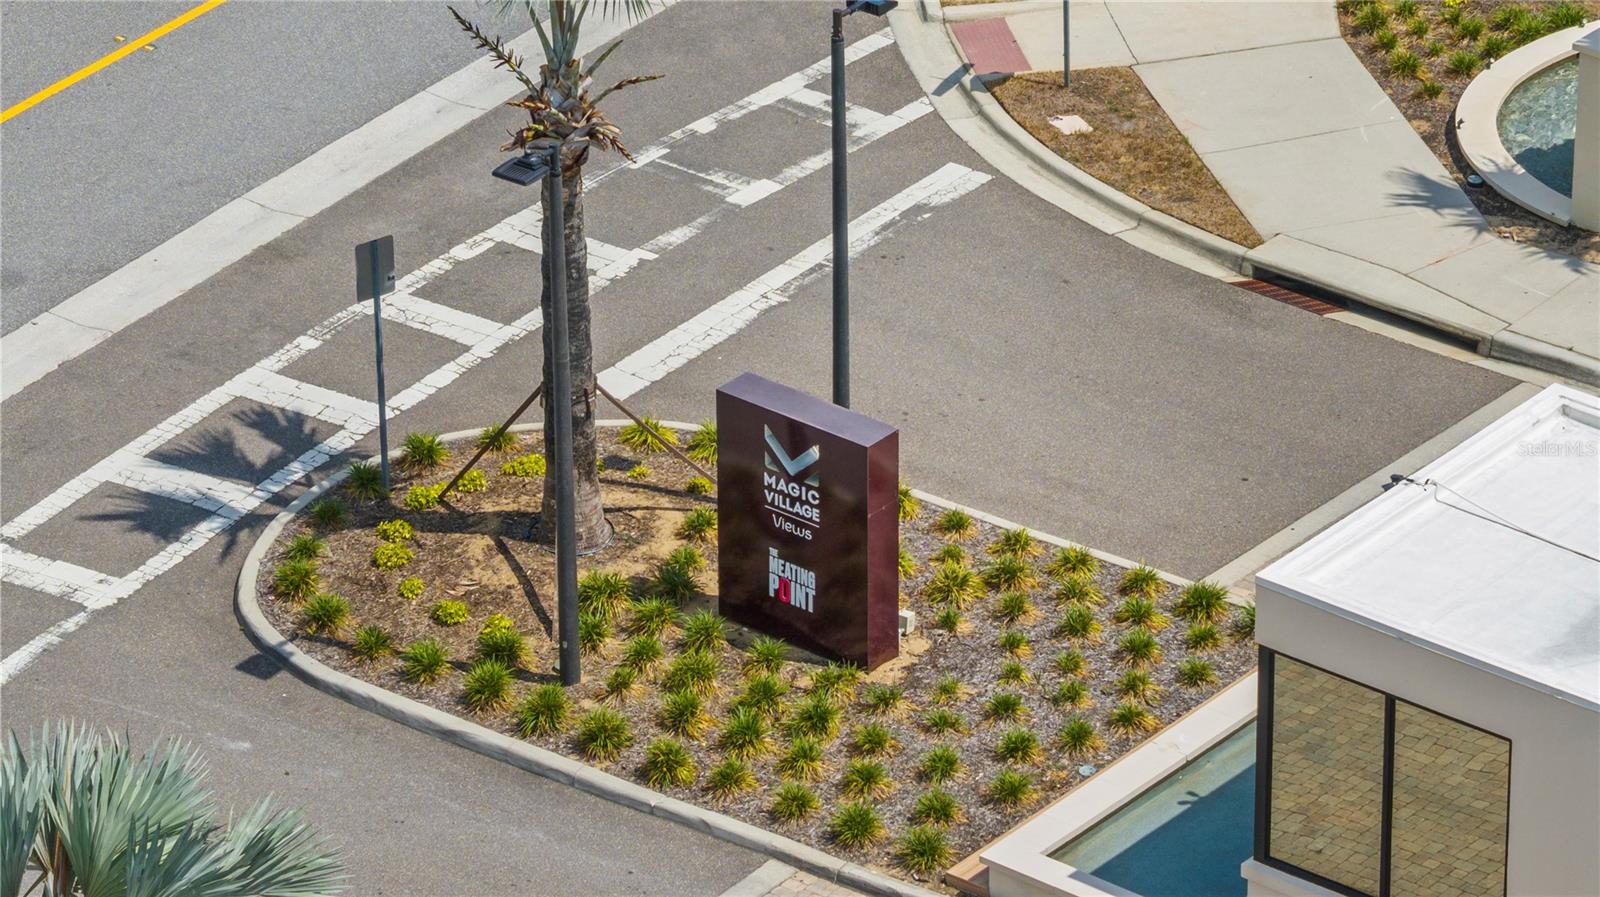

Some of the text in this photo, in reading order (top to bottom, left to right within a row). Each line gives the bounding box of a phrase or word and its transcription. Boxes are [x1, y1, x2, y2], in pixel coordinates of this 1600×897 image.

[764, 471, 820, 505] MAGIC
[764, 489, 820, 522] VILLAGE
[772, 513, 812, 540] Views
[769, 555, 815, 589] MEATING
[769, 572, 815, 613] POINT
